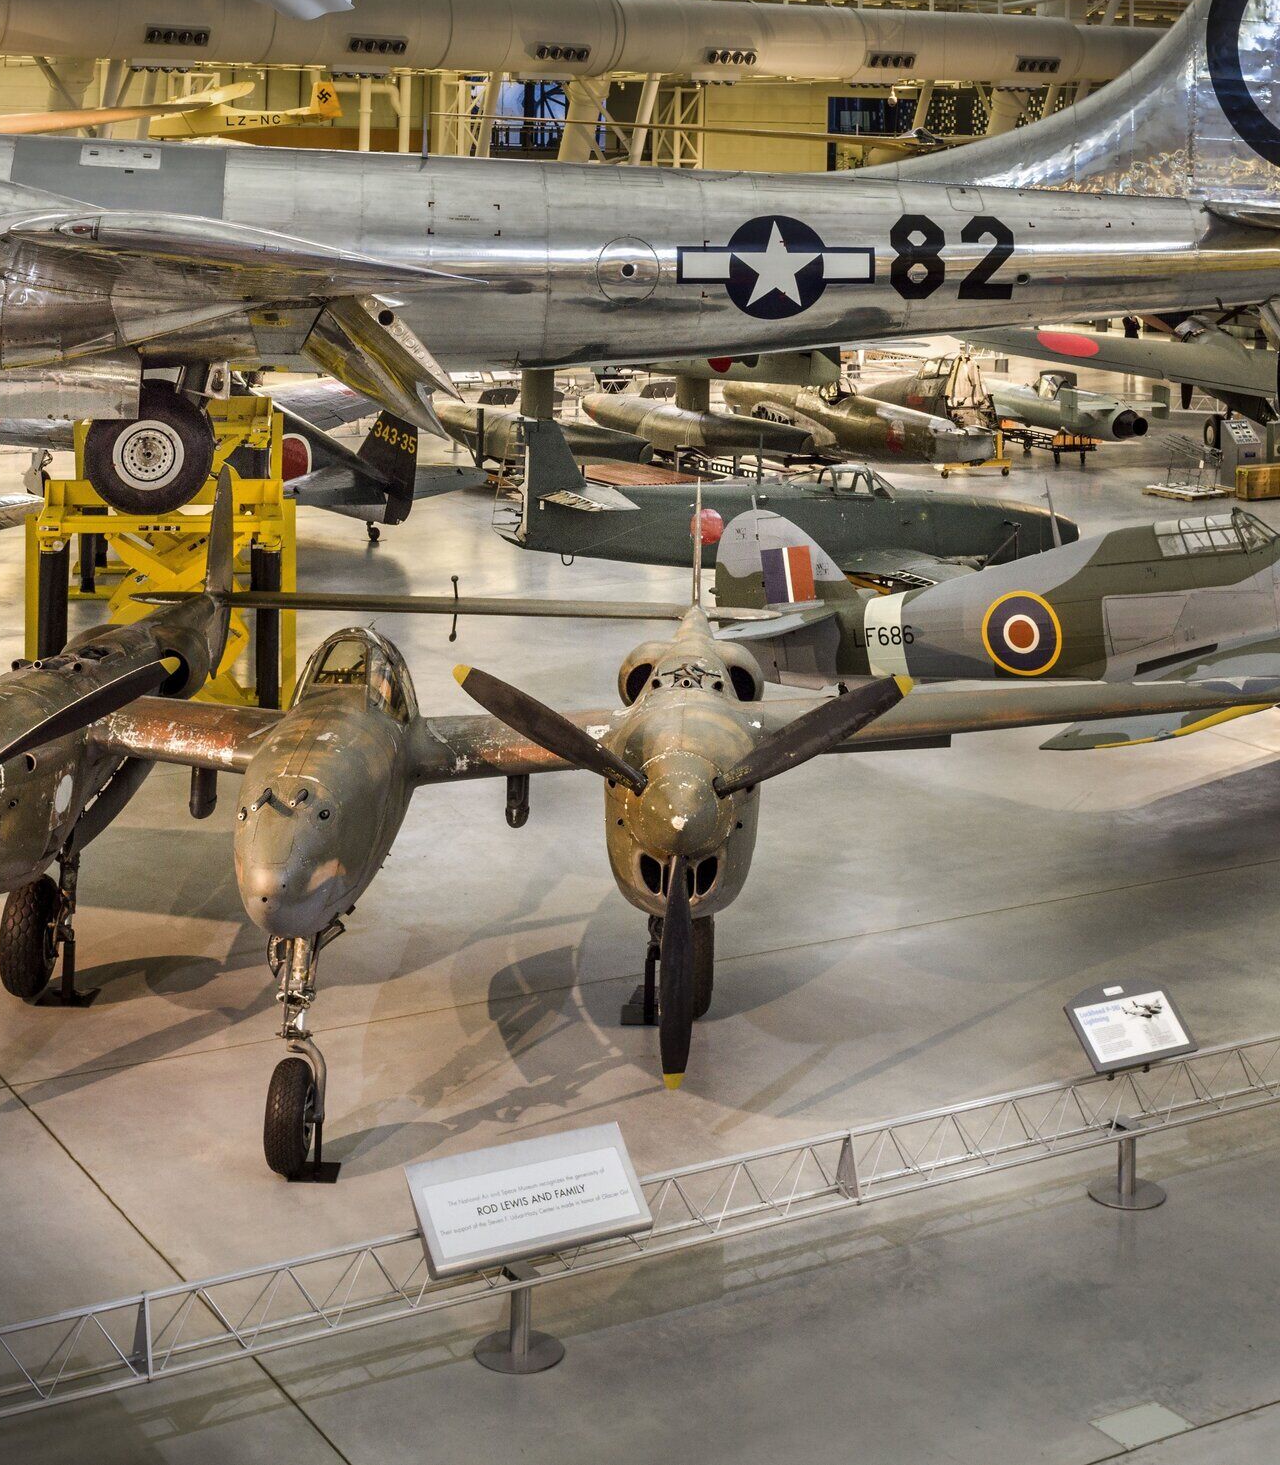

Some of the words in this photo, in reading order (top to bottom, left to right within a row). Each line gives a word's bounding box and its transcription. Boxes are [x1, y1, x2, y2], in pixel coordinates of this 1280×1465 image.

[226, 115, 281, 126] LZ-NC
[889, 213, 1015, 300] 82
[374, 420, 417, 454] 343-35
[853, 625, 915, 648] LF686
[458, 1196, 480, 1205] National
[501, 1187, 517, 1196] Space
[518, 1183, 540, 1192] Museum
[477, 1203, 498, 1216] ROD
[500, 1196, 529, 1211] LEWIS
[531, 1191, 553, 1204] AND
[555, 1183, 586, 1199] FAMILY
